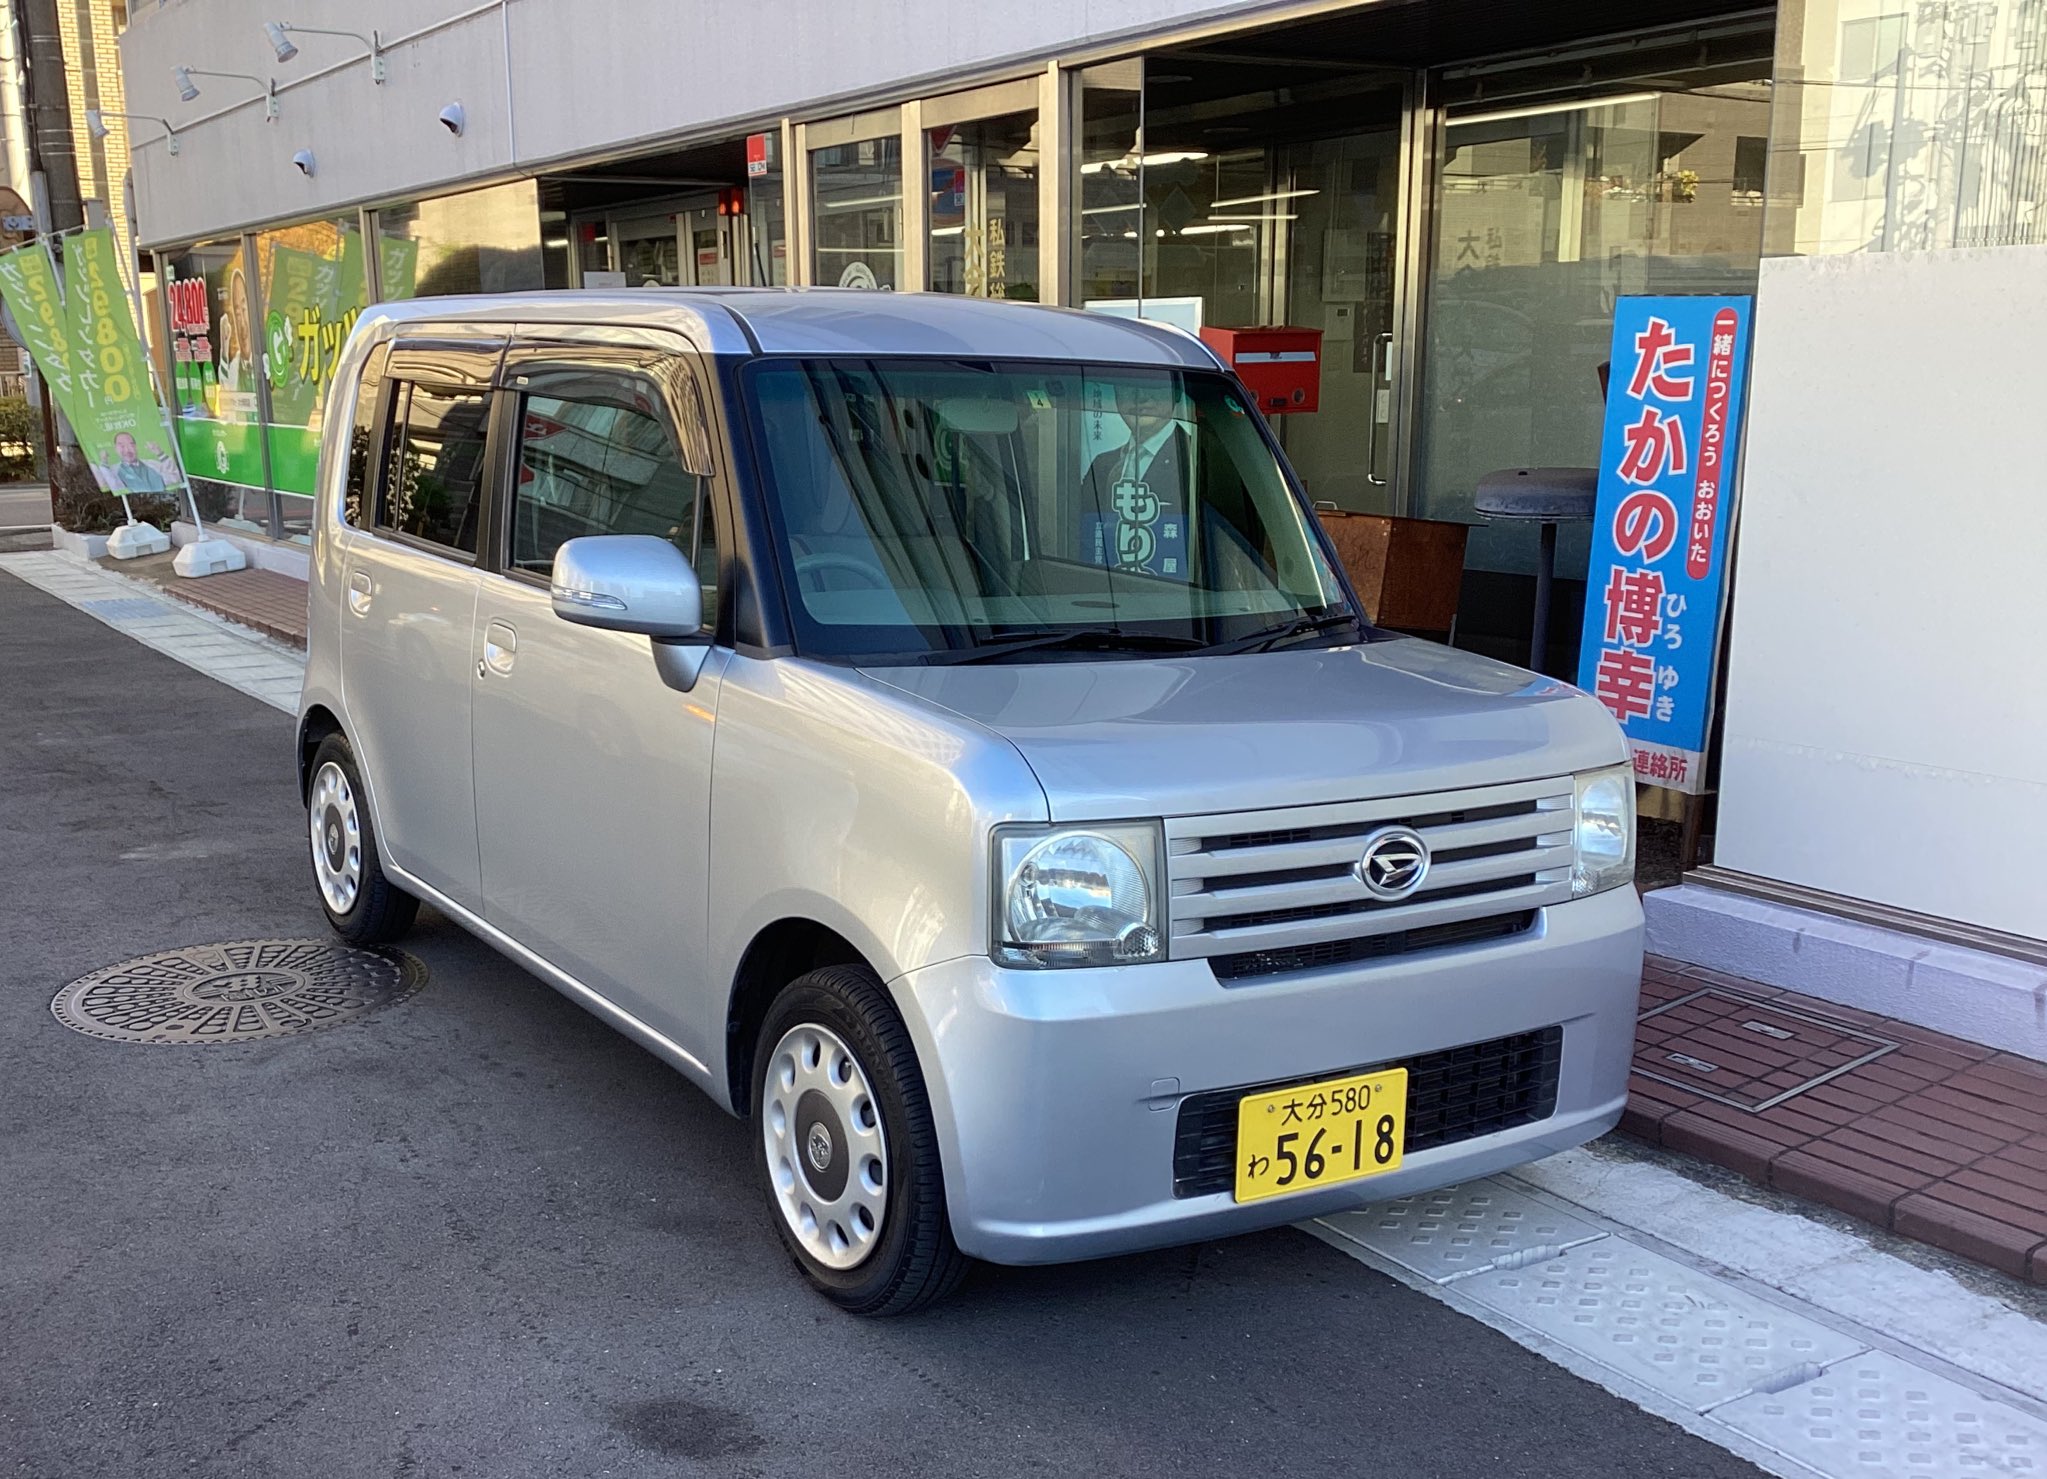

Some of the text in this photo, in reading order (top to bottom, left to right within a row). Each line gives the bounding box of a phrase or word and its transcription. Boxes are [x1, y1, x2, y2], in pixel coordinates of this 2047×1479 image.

[1689, 318, 1735, 564] 一緒につくろう おおいた
[1114, 480, 1158, 574] もり
[1595, 315, 1695, 726] たかの博幸
[1654, 592, 1688, 723] ひろ ゆき
[1632, 748, 1688, 783] 連絡所
[1276, 1113, 1395, 1186] 56-18
